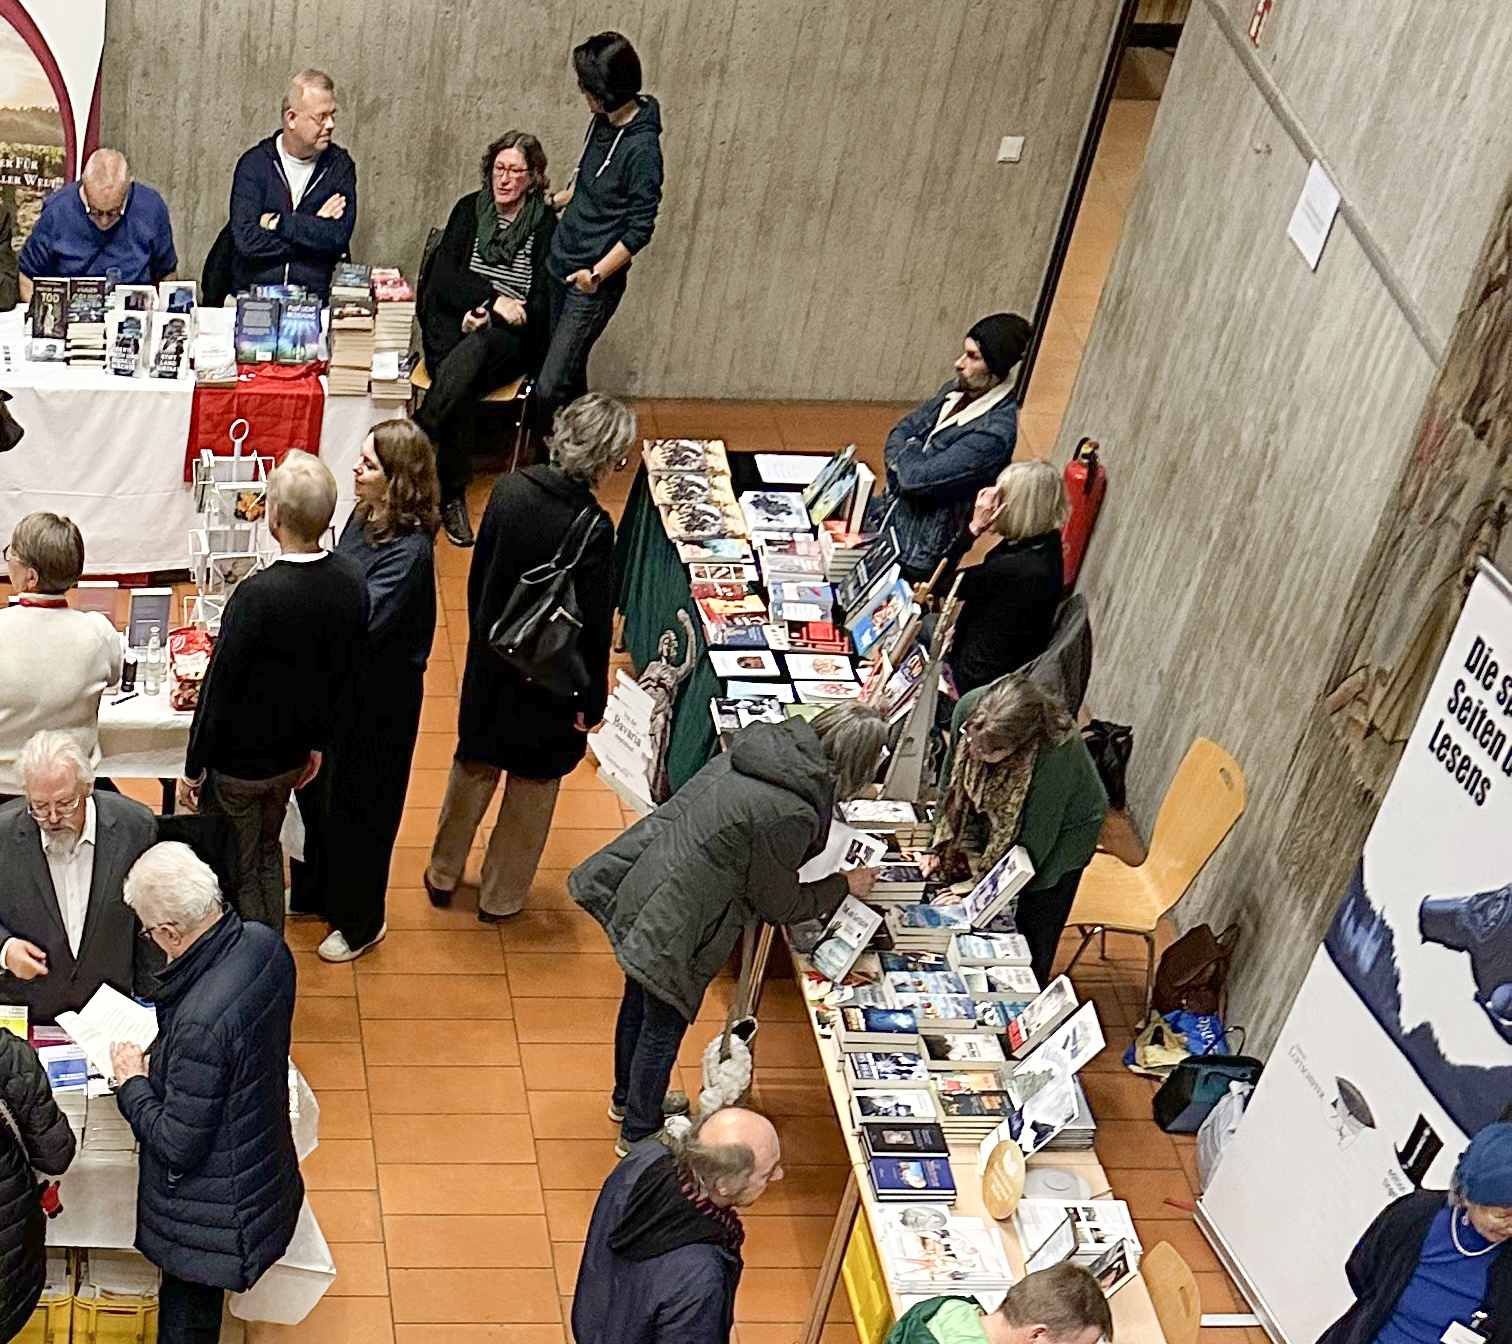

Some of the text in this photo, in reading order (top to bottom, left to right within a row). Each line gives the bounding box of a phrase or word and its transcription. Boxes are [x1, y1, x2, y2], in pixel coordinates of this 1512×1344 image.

[1464, 634, 1498, 691] Die
[612, 713, 642, 748] Bavaria
[1447, 679, 1507, 762] Seiten
[1428, 718, 1491, 806] Lesens
